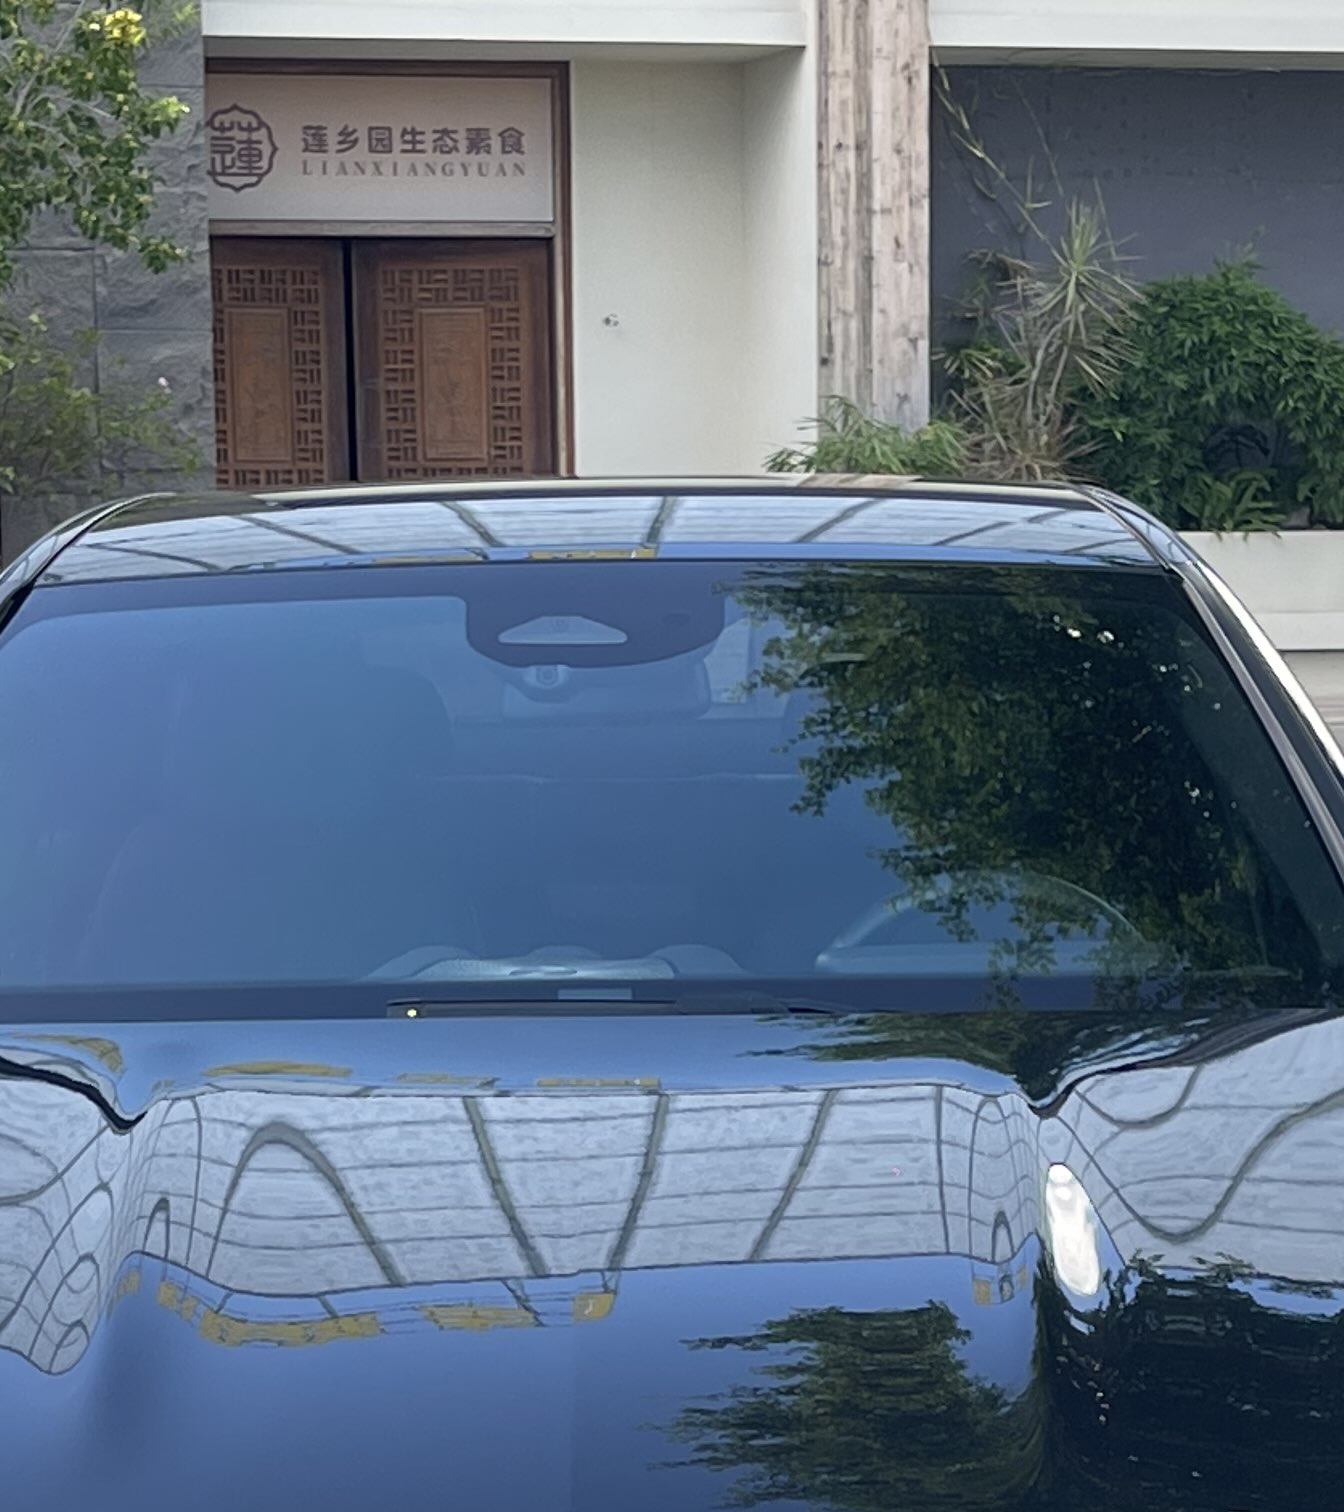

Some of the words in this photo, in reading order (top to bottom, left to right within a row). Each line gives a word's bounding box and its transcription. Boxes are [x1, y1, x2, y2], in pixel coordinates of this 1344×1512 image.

[301, 124, 526, 156] 莲乡园生态素食
[301, 160, 527, 178] LIANXIANGYUAN
